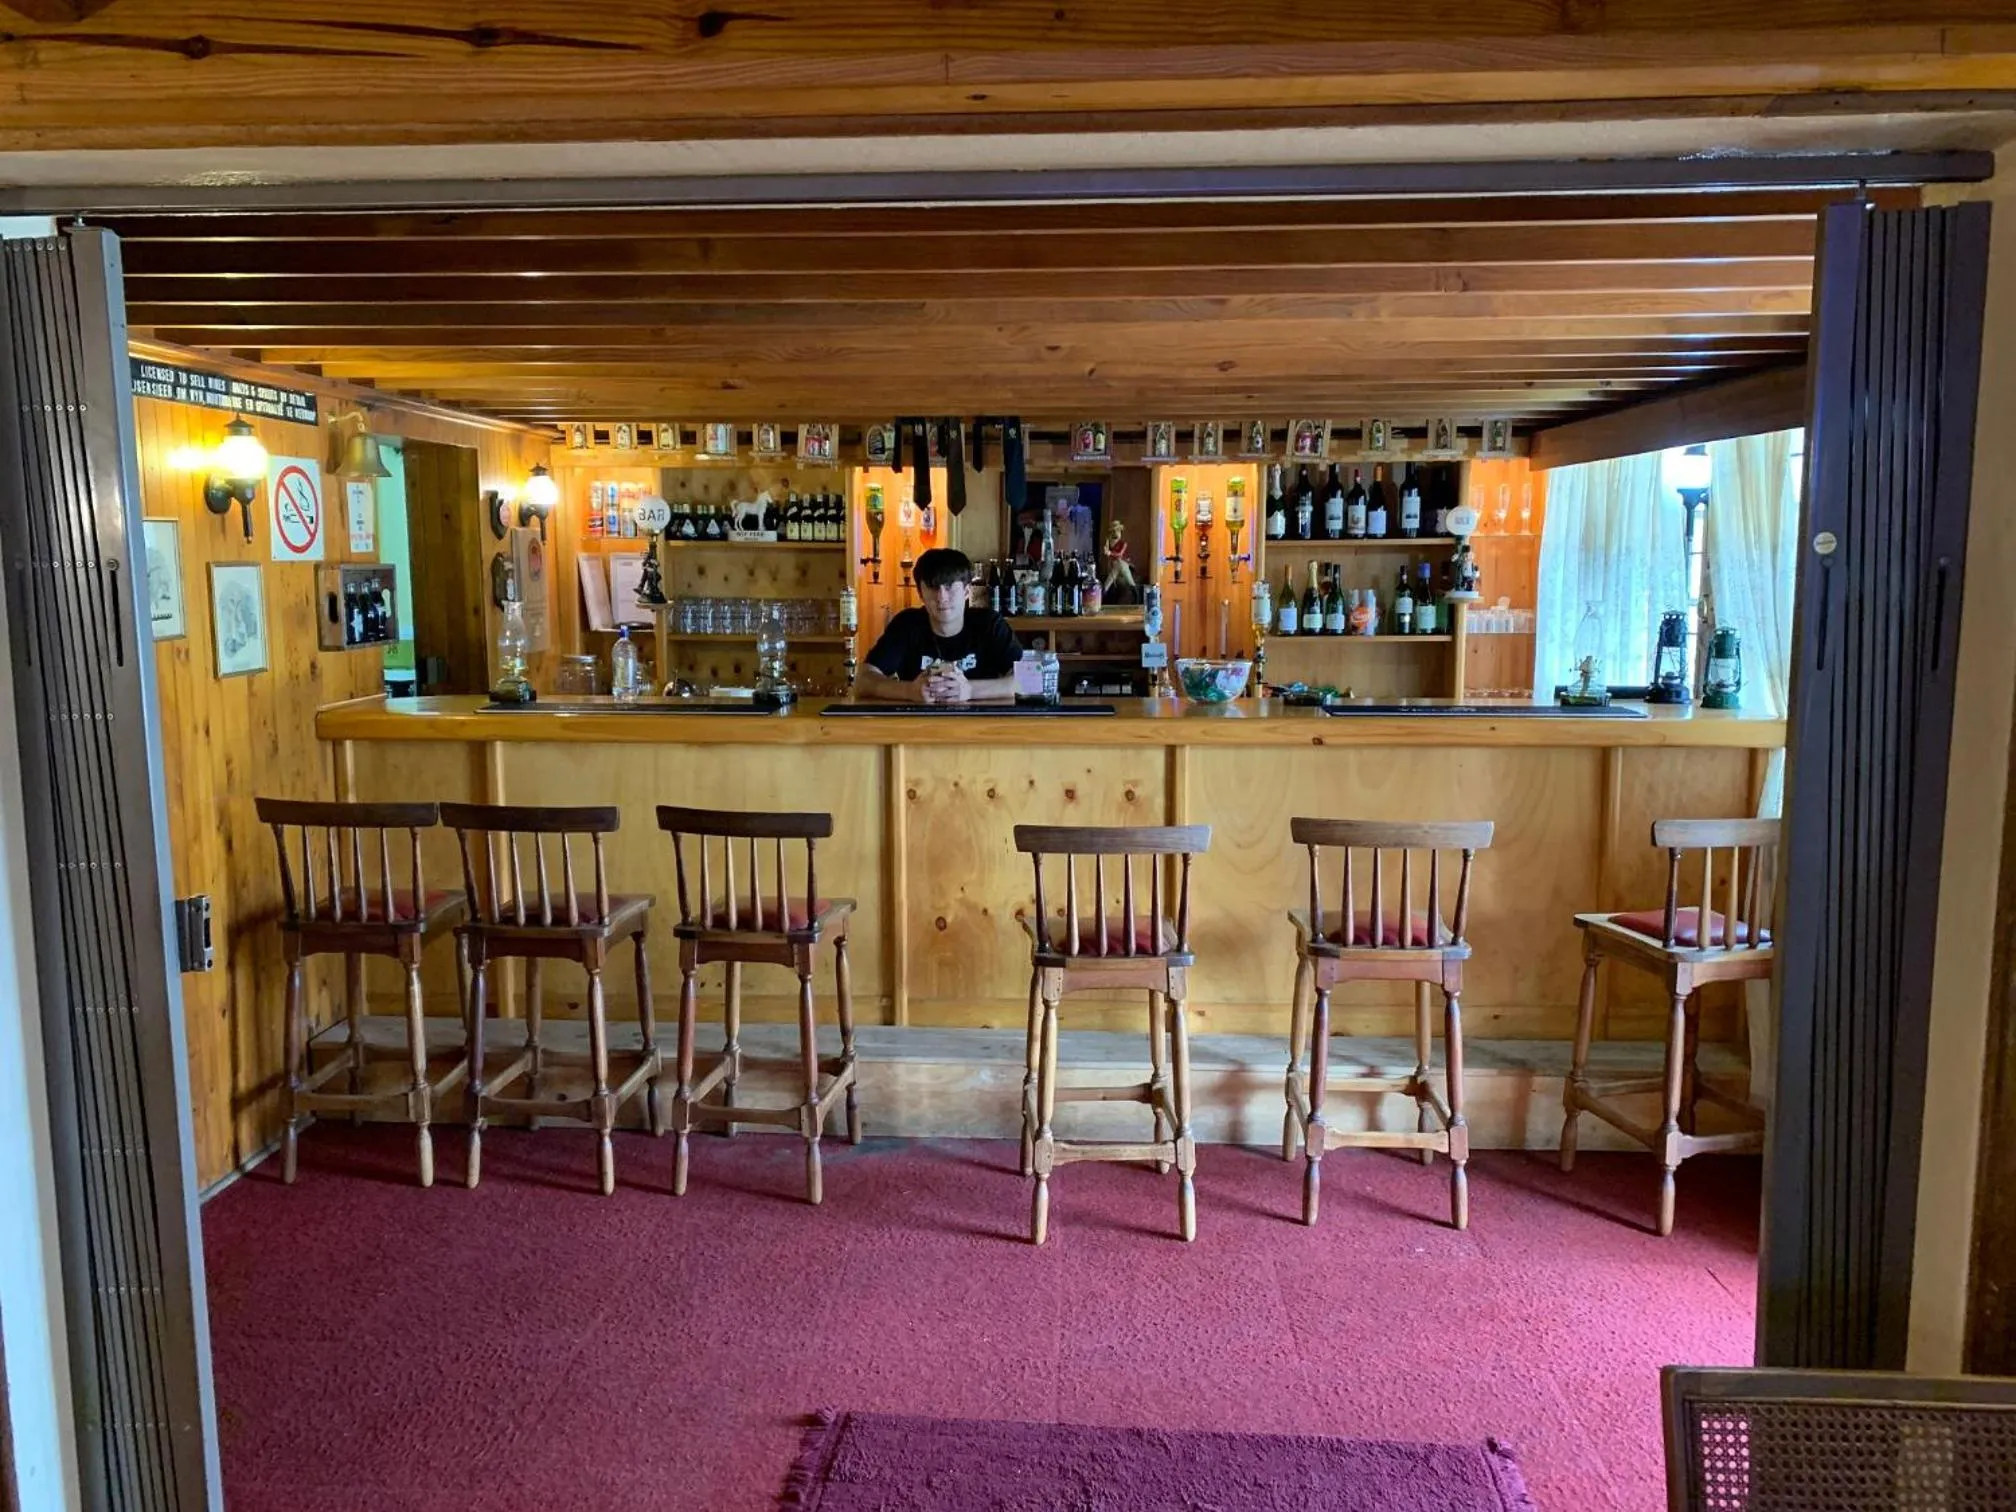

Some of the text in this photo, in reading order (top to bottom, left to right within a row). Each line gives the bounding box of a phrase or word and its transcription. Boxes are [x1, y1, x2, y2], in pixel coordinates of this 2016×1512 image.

[141, 363, 174, 382] LICENSED
[178, 371, 188, 385] TO
[189, 374, 206, 389] SELL
[638, 507, 665, 522] BAR
